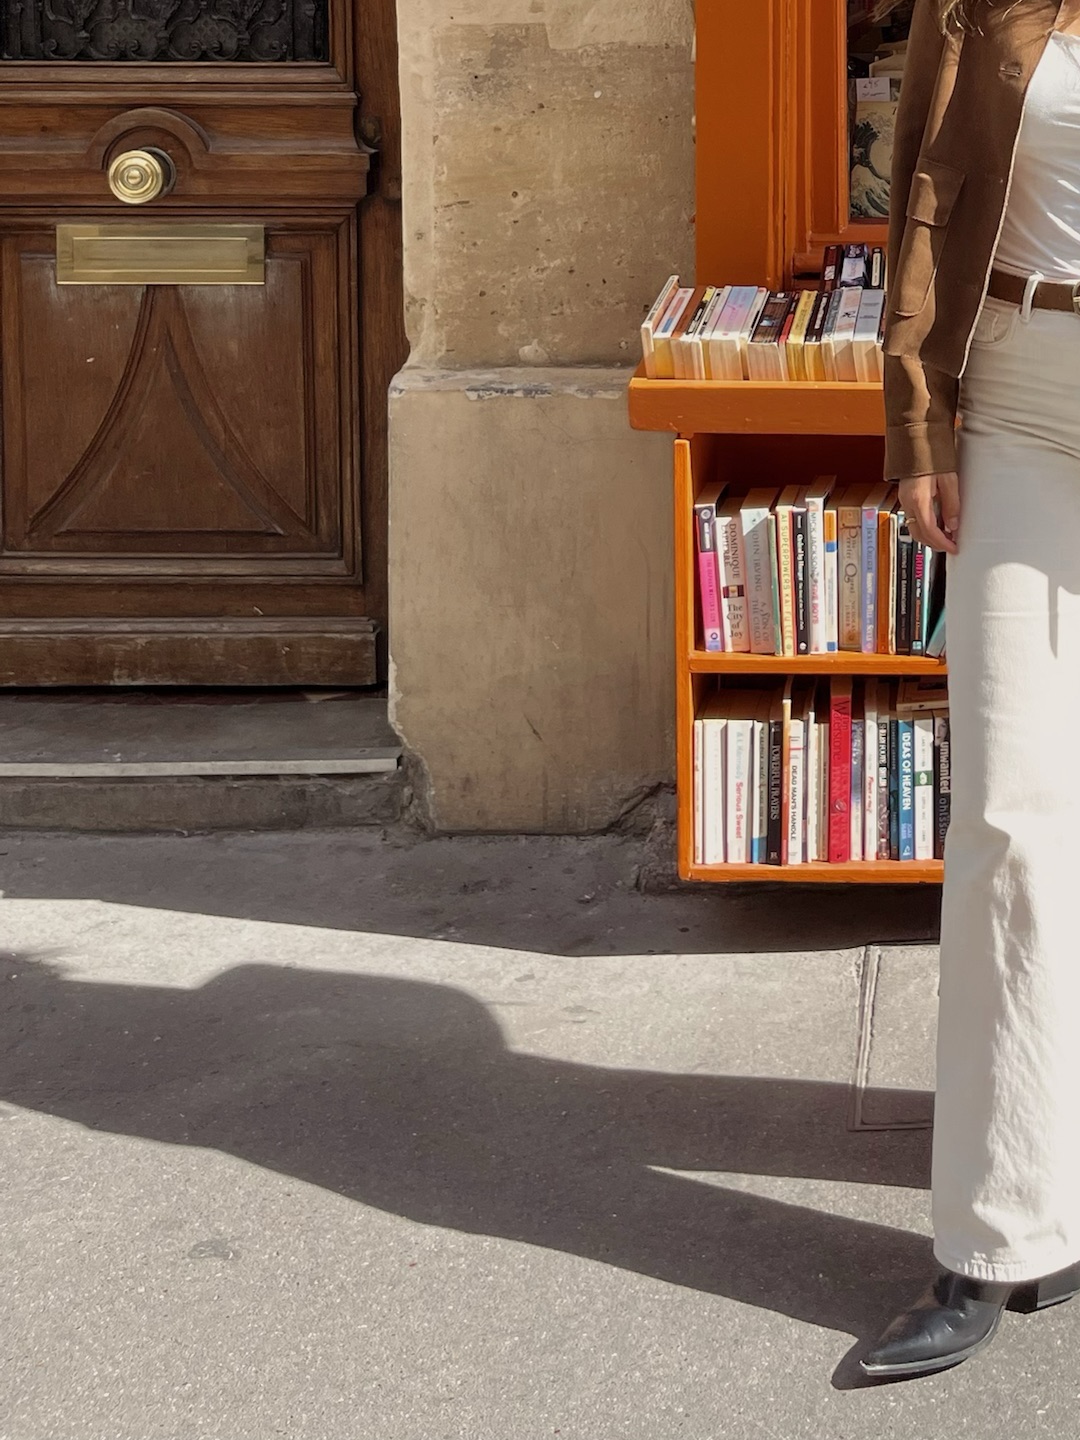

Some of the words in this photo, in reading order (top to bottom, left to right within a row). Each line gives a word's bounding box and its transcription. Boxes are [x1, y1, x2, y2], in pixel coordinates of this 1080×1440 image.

[781, 514, 787, 523] AI
[721, 524, 731, 568] LAPIERRE
[729, 523, 740, 579] DOMINIQUE
[751, 529, 760, 555] JOHN
[810, 535, 818, 573] JACKSON
[781, 526, 790, 590] SUPERPOWERS
[915, 553, 924, 580] BODY
[752, 558, 762, 592] IRVING
[811, 583, 819, 602] FIVE
[727, 603, 743, 612] The
[727, 612, 743, 623] City
[751, 598, 759, 615] THE
[759, 609, 770, 629] SON
[729, 629, 744, 640] Joy
[732, 622, 741, 630] of
[752, 616, 761, 646] CIRCUS
[763, 632, 770, 642] OF
[832, 700, 851, 761] Waterstone
[902, 732, 911, 759] IDEAS
[771, 744, 781, 787] POWERFUL
[902, 759, 911, 773] OF
[939, 741, 951, 794] unwanted
[735, 781, 743, 812] Serious
[770, 787, 780, 820] PRAYERS
[790, 786, 798, 811] MAN'S
[902, 776, 911, 811] HEAVEN
[735, 814, 743, 839] Sweet
[938, 797, 949, 842] ohlsson
